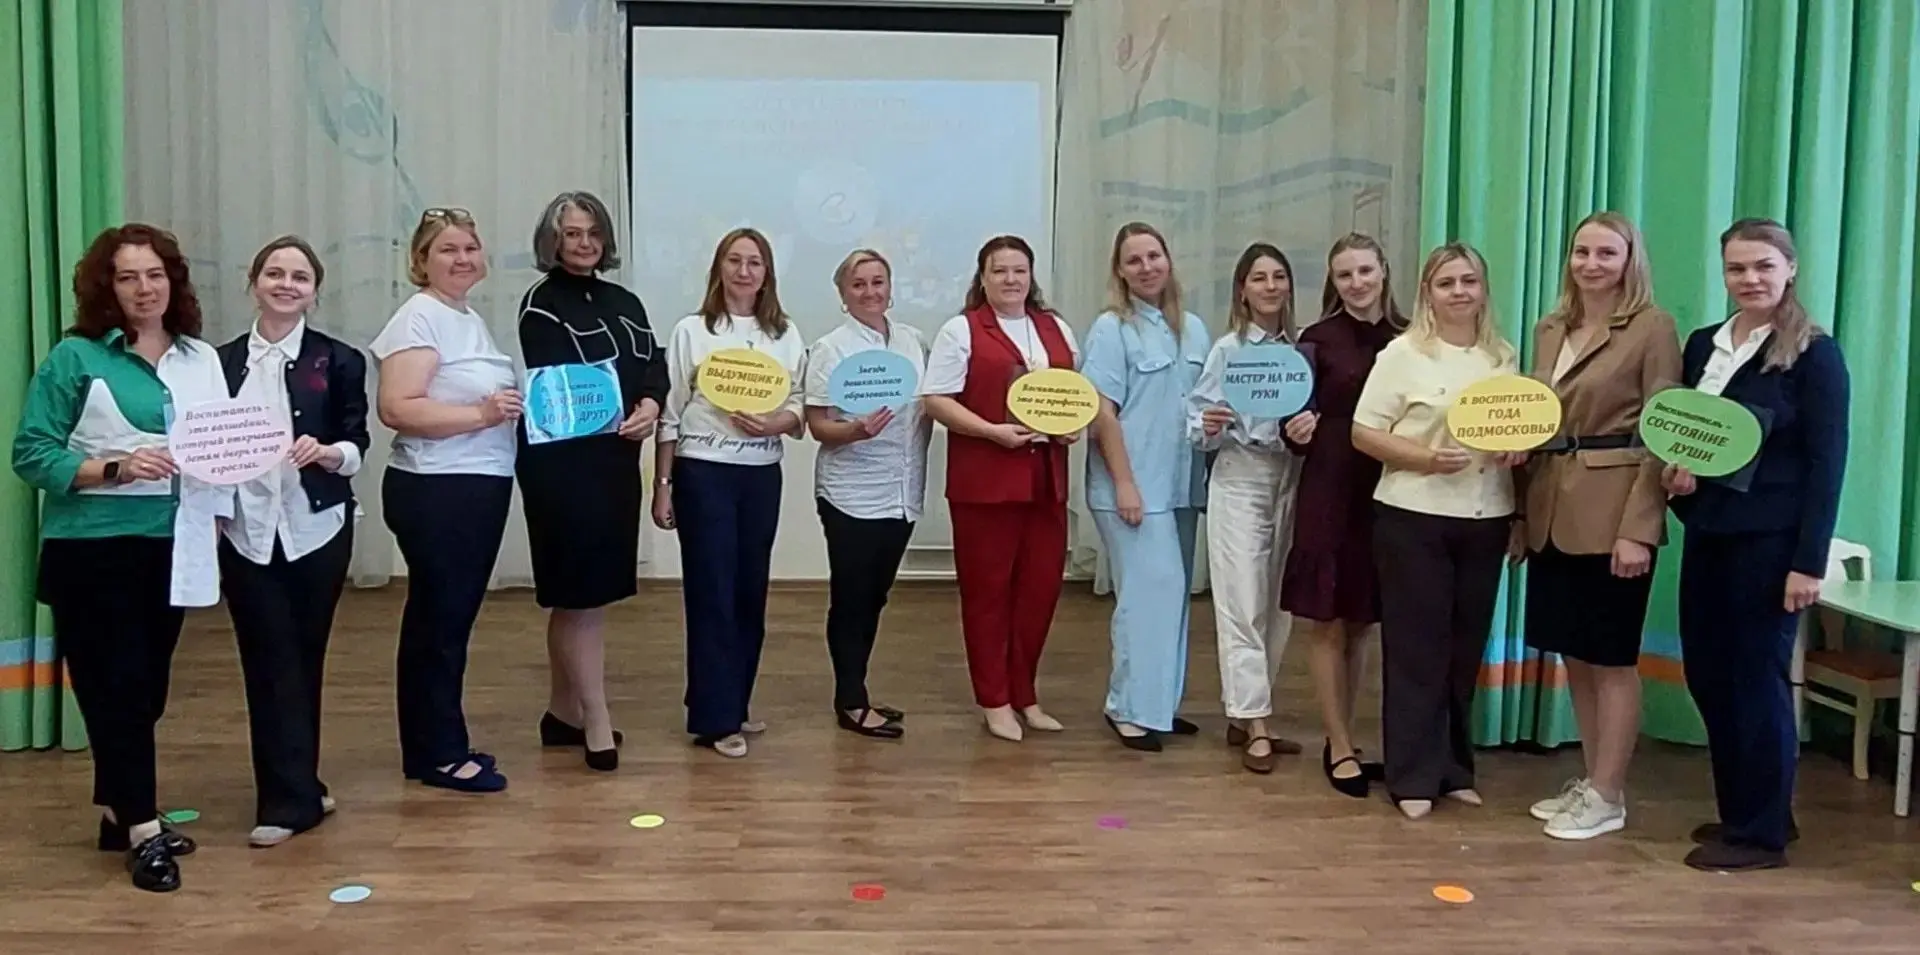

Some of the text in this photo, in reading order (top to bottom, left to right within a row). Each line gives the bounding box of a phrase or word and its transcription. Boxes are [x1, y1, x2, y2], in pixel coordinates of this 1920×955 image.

[706, 367, 784, 386] ВЫДУМЩИК И
[843, 378, 903, 388] дошкольного
[1225, 372, 1307, 384] МАСТЕР НА ВСЕ
[714, 384, 772, 399] ФАНТАЗЕР
[1022, 384, 1080, 395] Воспитатель
[1251, 389, 1279, 400] РУКИ
[1459, 393, 1548, 405] Я ВОСПИТАТЕЛЬ
[185, 405, 262, 420] Воспитатель
[1487, 408, 1521, 420] ГОДА
[1654, 402, 1723, 429] Воспитатель
[188, 426, 209, 435] это
[1456, 422, 1556, 438] ПОДМОСКОВЬЯ
[1646, 415, 1730, 447] СОСТОЯНИЕ
[176, 430, 286, 450] который открывает
[185, 453, 220, 464] детям
[222, 449, 250, 459] дверь
[261, 444, 280, 454] мир
[1667, 441, 1716, 463] ДУШИ
